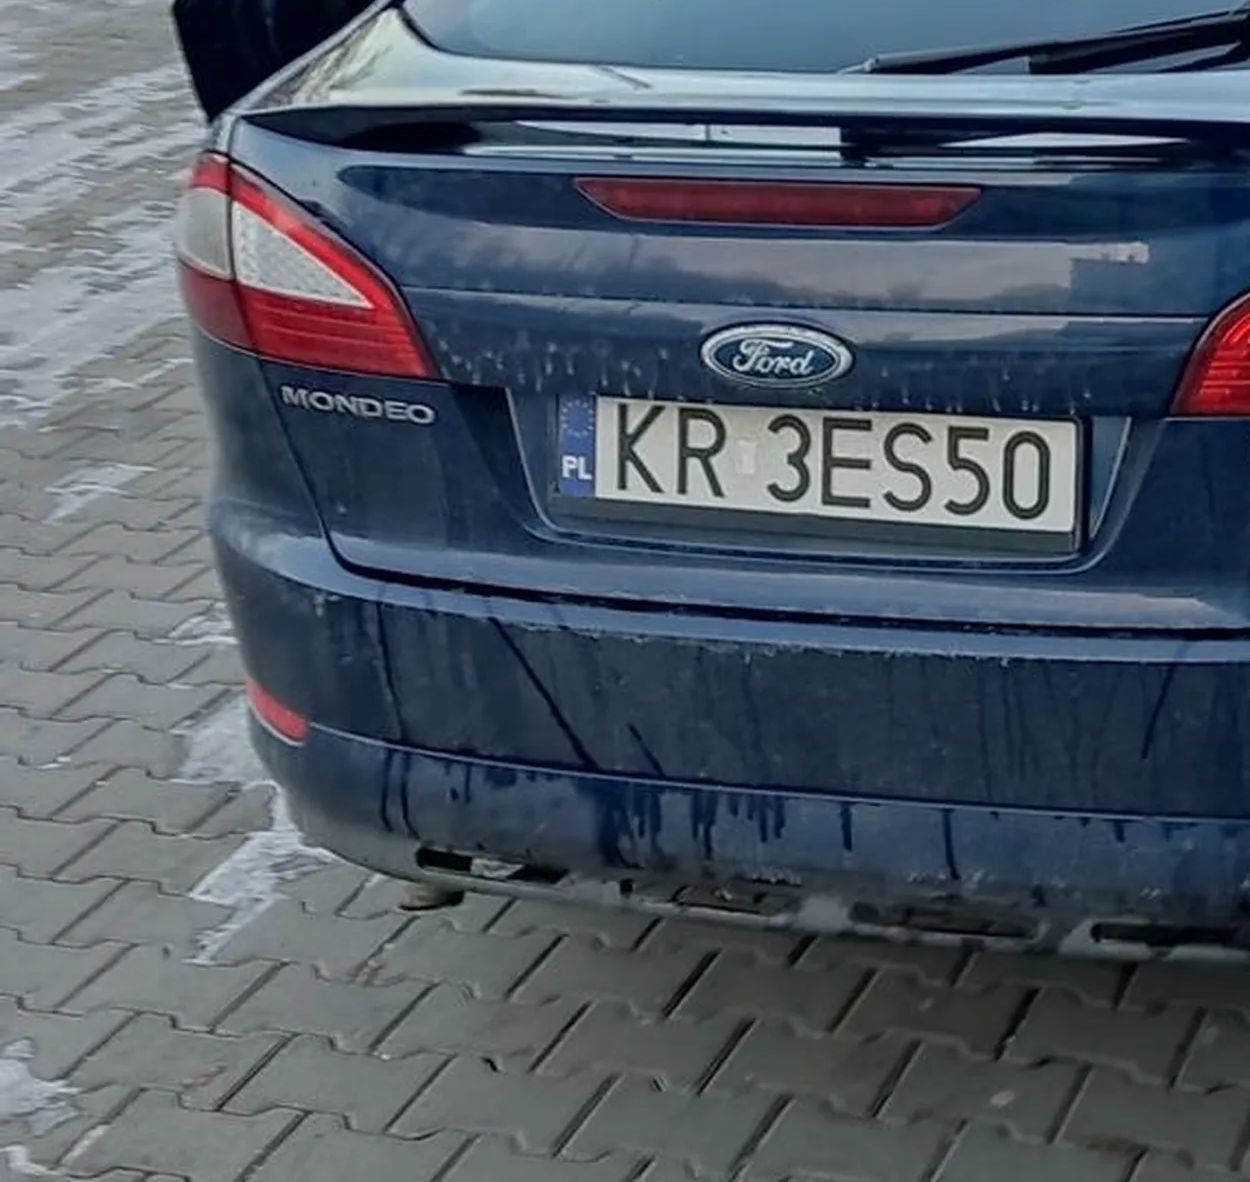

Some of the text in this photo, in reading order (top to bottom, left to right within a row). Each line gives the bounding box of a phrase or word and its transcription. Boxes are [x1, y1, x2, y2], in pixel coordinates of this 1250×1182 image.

[732, 338, 814, 375] Ford
[280, 385, 435, 424] MONDEO
[562, 455, 593, 480] PL
[616, 403, 1052, 520] KR 3ES50
